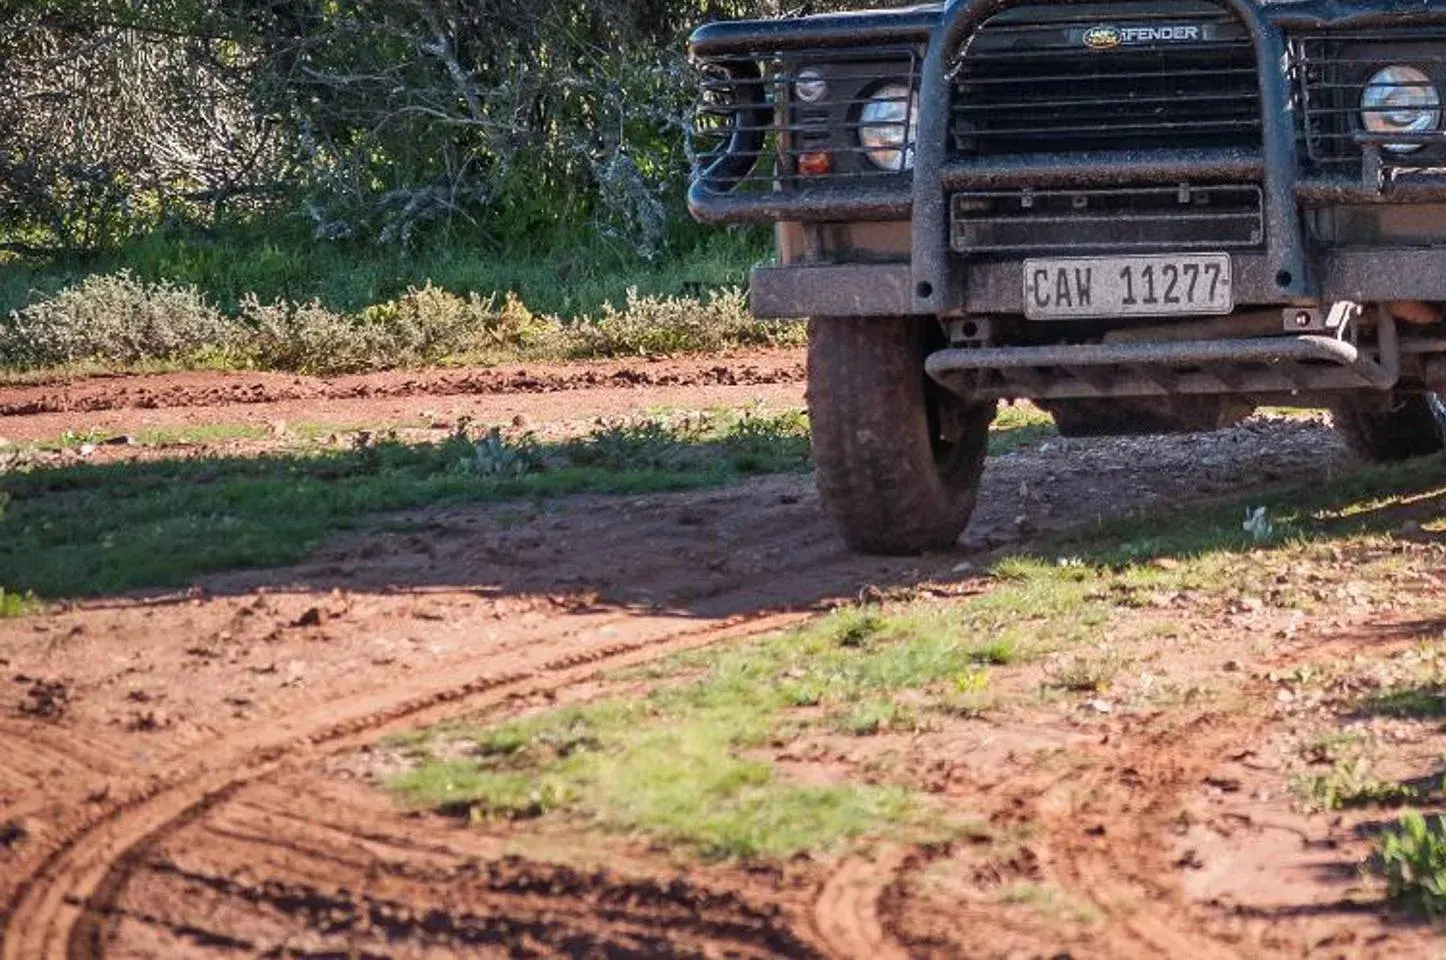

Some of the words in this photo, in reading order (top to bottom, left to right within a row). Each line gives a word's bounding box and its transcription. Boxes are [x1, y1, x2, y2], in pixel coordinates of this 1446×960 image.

[1120, 26, 1198, 41] FENDER
[1033, 267, 1092, 307] CAW
[1119, 263, 1220, 305] 11277
